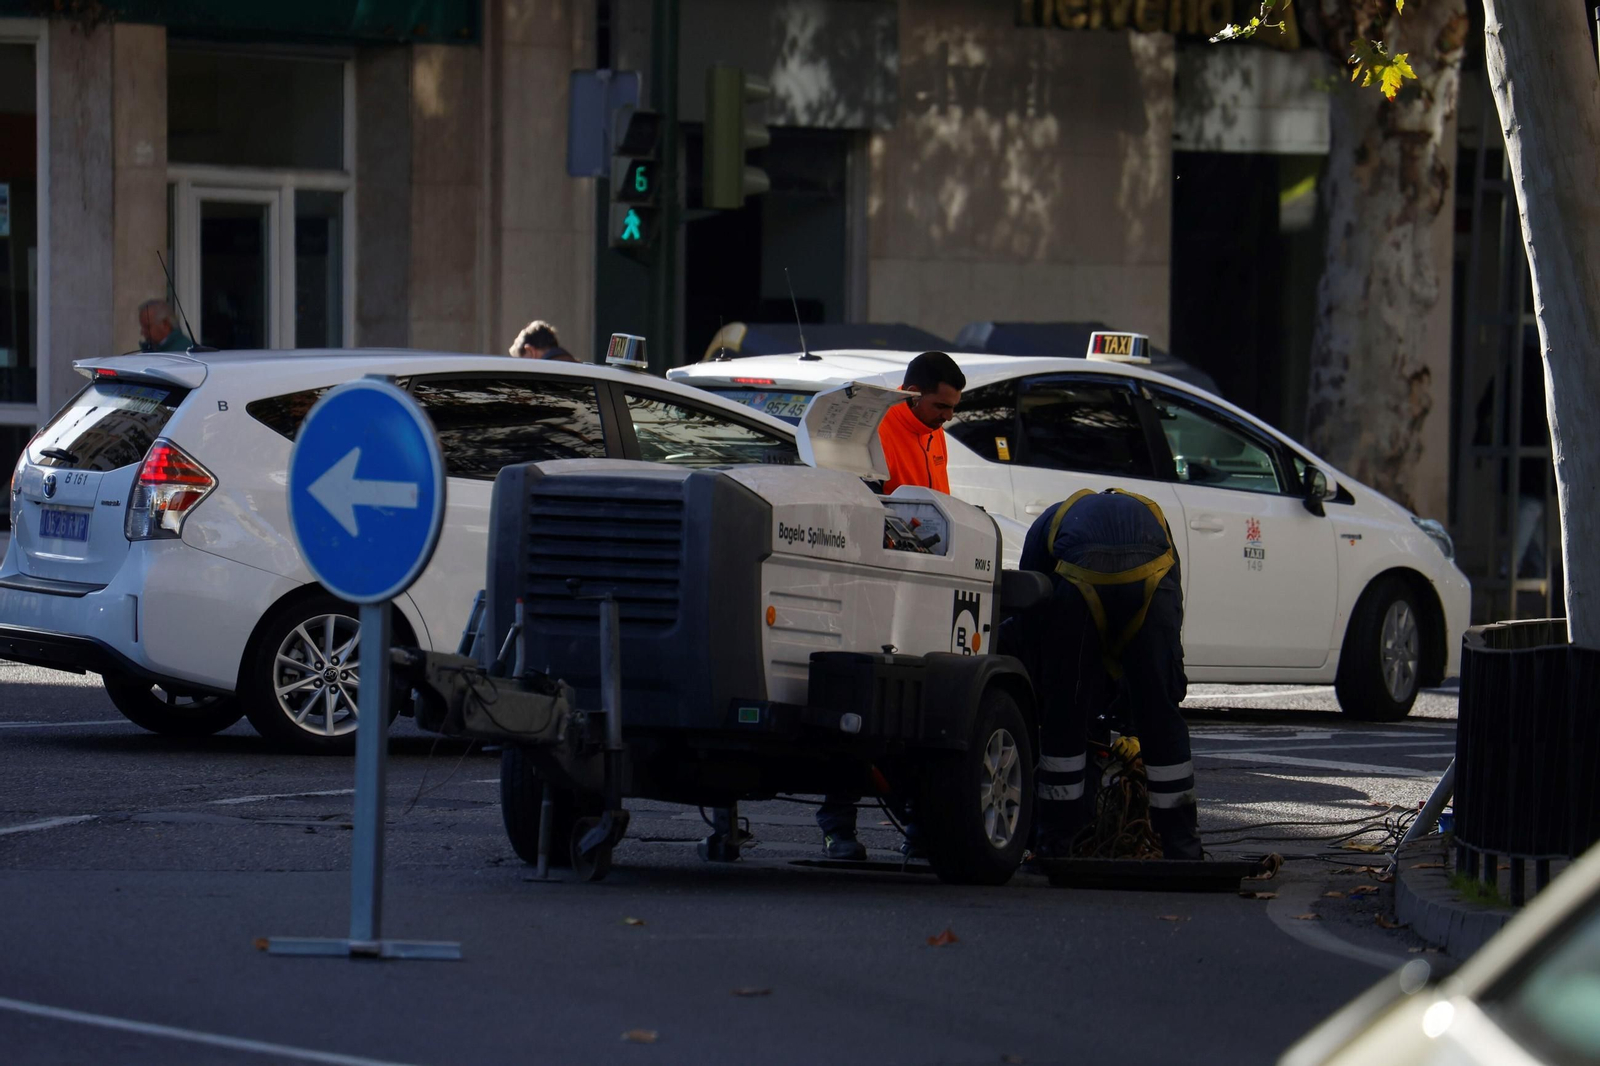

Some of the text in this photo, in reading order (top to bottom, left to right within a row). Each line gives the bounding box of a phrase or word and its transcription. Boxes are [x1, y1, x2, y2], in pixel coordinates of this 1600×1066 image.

[635, 166, 648, 192] 6
[1104, 335, 1132, 355] TAXI
[217, 400, 229, 412] B
[765, 401, 787, 415] 957
[73, 473, 89, 486] 161
[778, 522, 846, 549] Bagela Spillwinde
[1246, 548, 1263, 558] TAXI
[975, 558, 986, 571] RKW
[1247, 560, 1263, 572] 149
